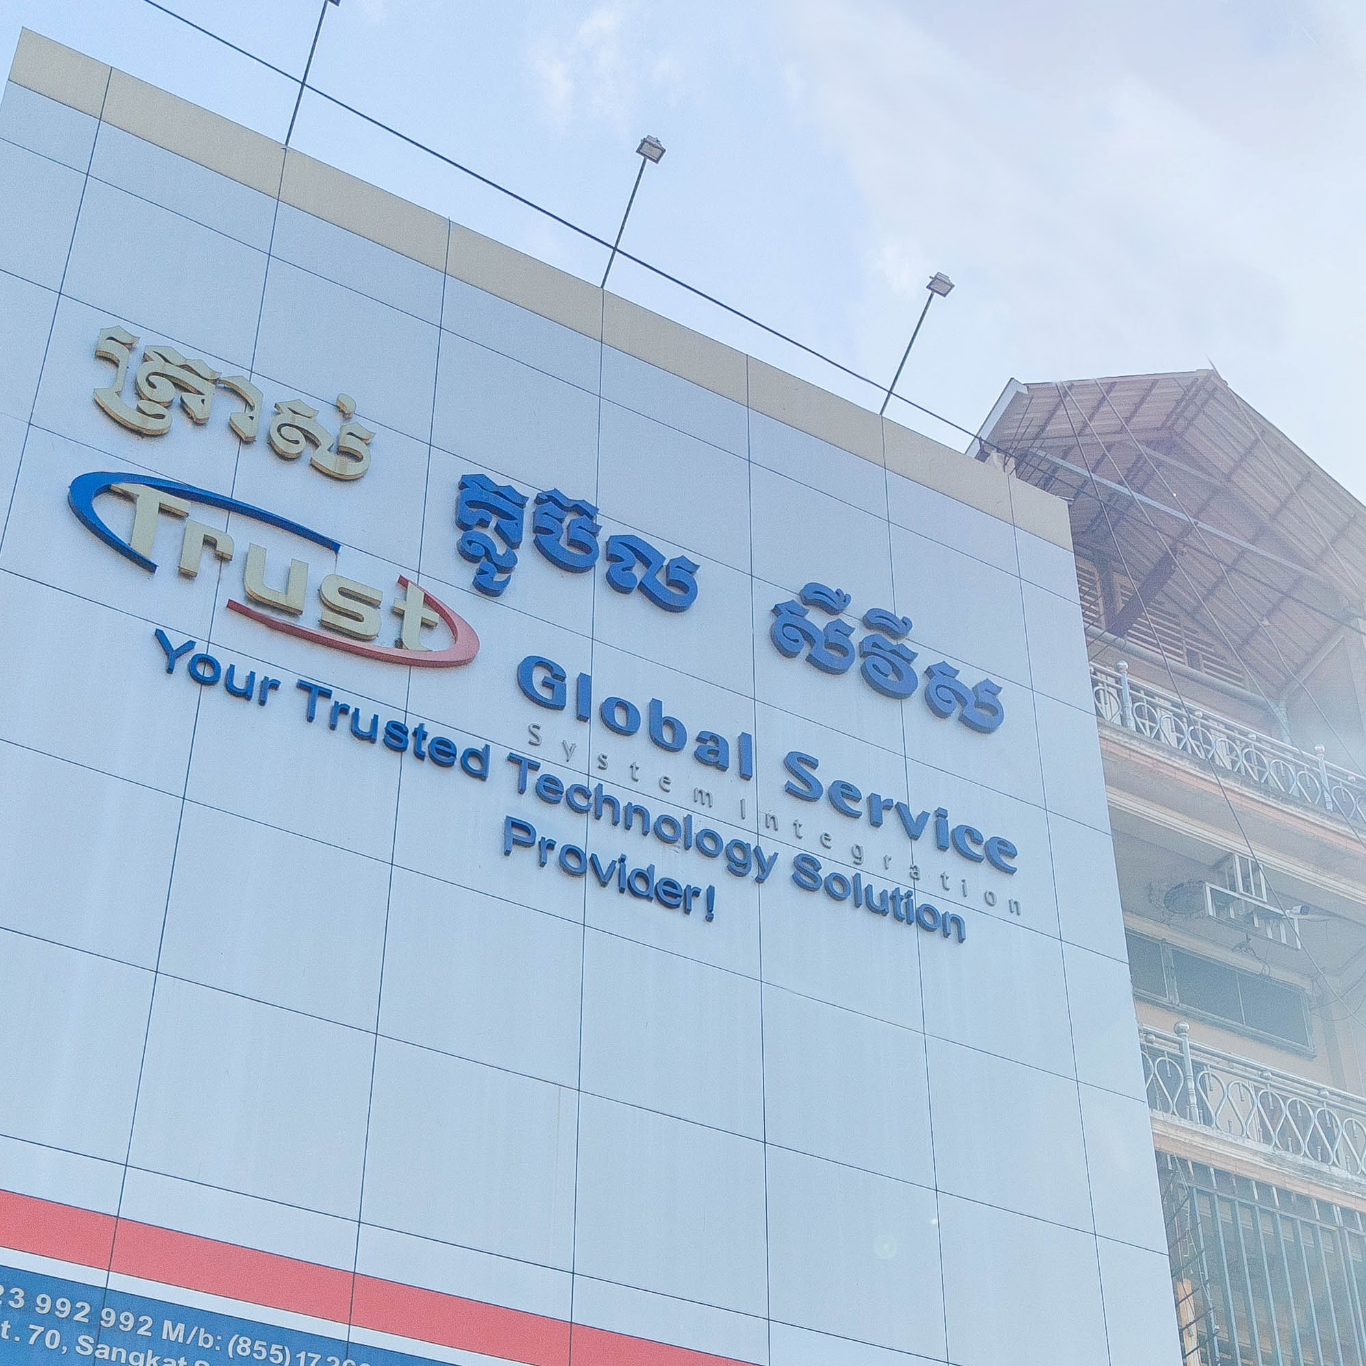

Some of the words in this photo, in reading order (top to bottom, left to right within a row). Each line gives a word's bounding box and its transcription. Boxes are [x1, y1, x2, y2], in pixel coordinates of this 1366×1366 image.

[110, 482, 439, 652] Trust
[154, 628, 281, 706] Your
[295, 679, 490, 782] Trusted
[506, 752, 780, 884] Technology
[791, 853, 967, 943] Solution
[517, 655, 753, 781] Global
[783, 750, 1019, 876] Service
[527, 722, 714, 808] System
[739, 797, 1023, 917] Integration
[503, 815, 718, 923] Provider!
[35, 1293, 91, 1324] 992
[100, 1307, 153, 1337] 992
[161, 1319, 223, 1352] M/b:
